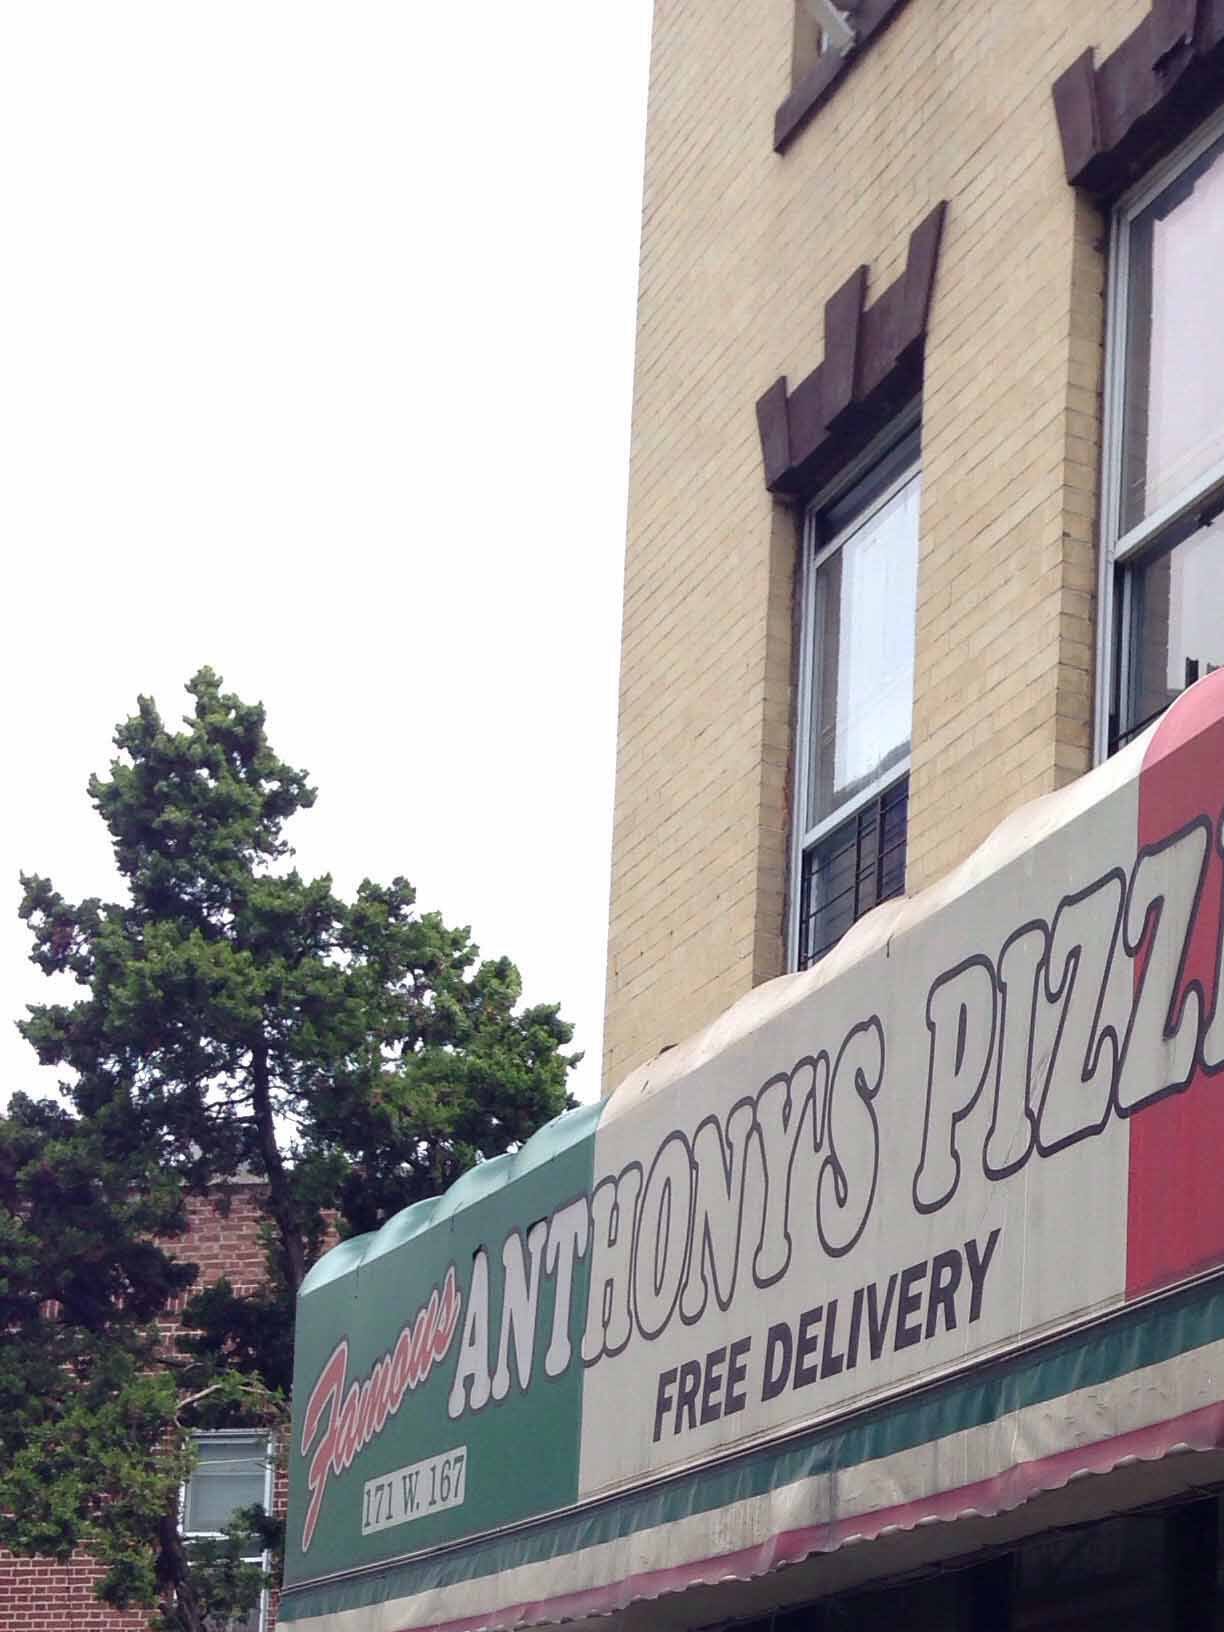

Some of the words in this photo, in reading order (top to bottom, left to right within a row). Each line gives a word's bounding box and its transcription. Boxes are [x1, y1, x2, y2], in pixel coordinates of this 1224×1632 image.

[301, 1266, 462, 1552] Famous
[447, 1014, 887, 1419] ANTHONY'S
[653, 1335, 752, 1443] FREE
[760, 1227, 1002, 1402] DELIVERY
[363, 1479, 394, 1529] 171
[401, 1470, 421, 1516] W.
[428, 1454, 465, 1507] 167
